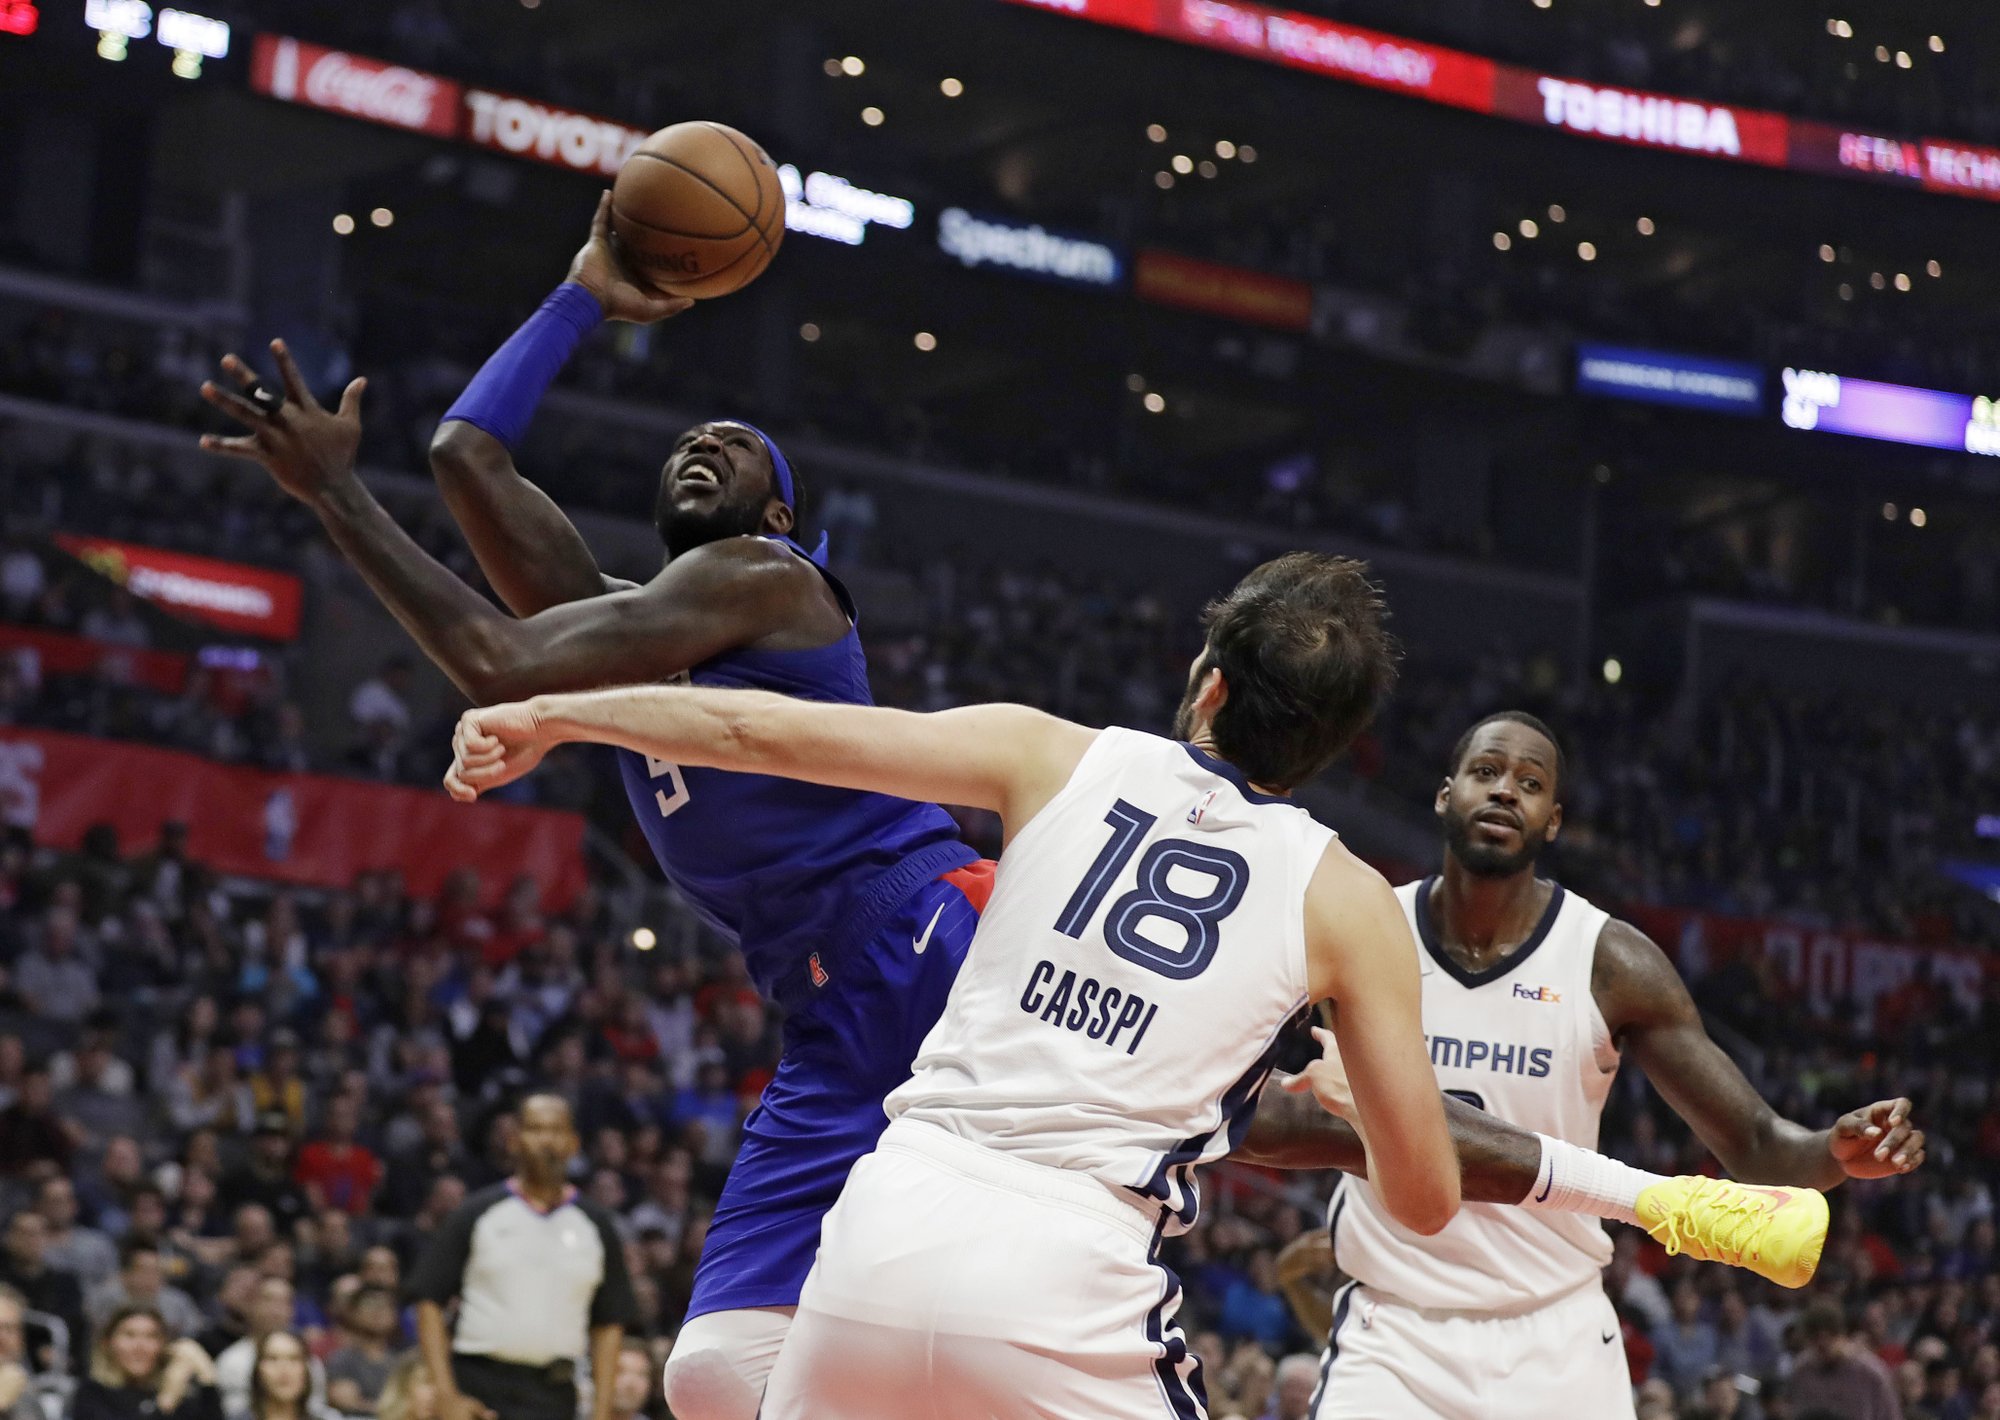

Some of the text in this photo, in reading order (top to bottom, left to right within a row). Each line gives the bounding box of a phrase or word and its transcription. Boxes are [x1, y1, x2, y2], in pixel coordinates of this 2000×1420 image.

[1538, 76, 1740, 157] TOSHIBA
[1053, 797, 1250, 980] 18
[1019, 960, 1159, 1055] CASSPI
[1512, 983, 1562, 1004] FedEx
[1426, 1035, 1552, 1077] MPHIS
